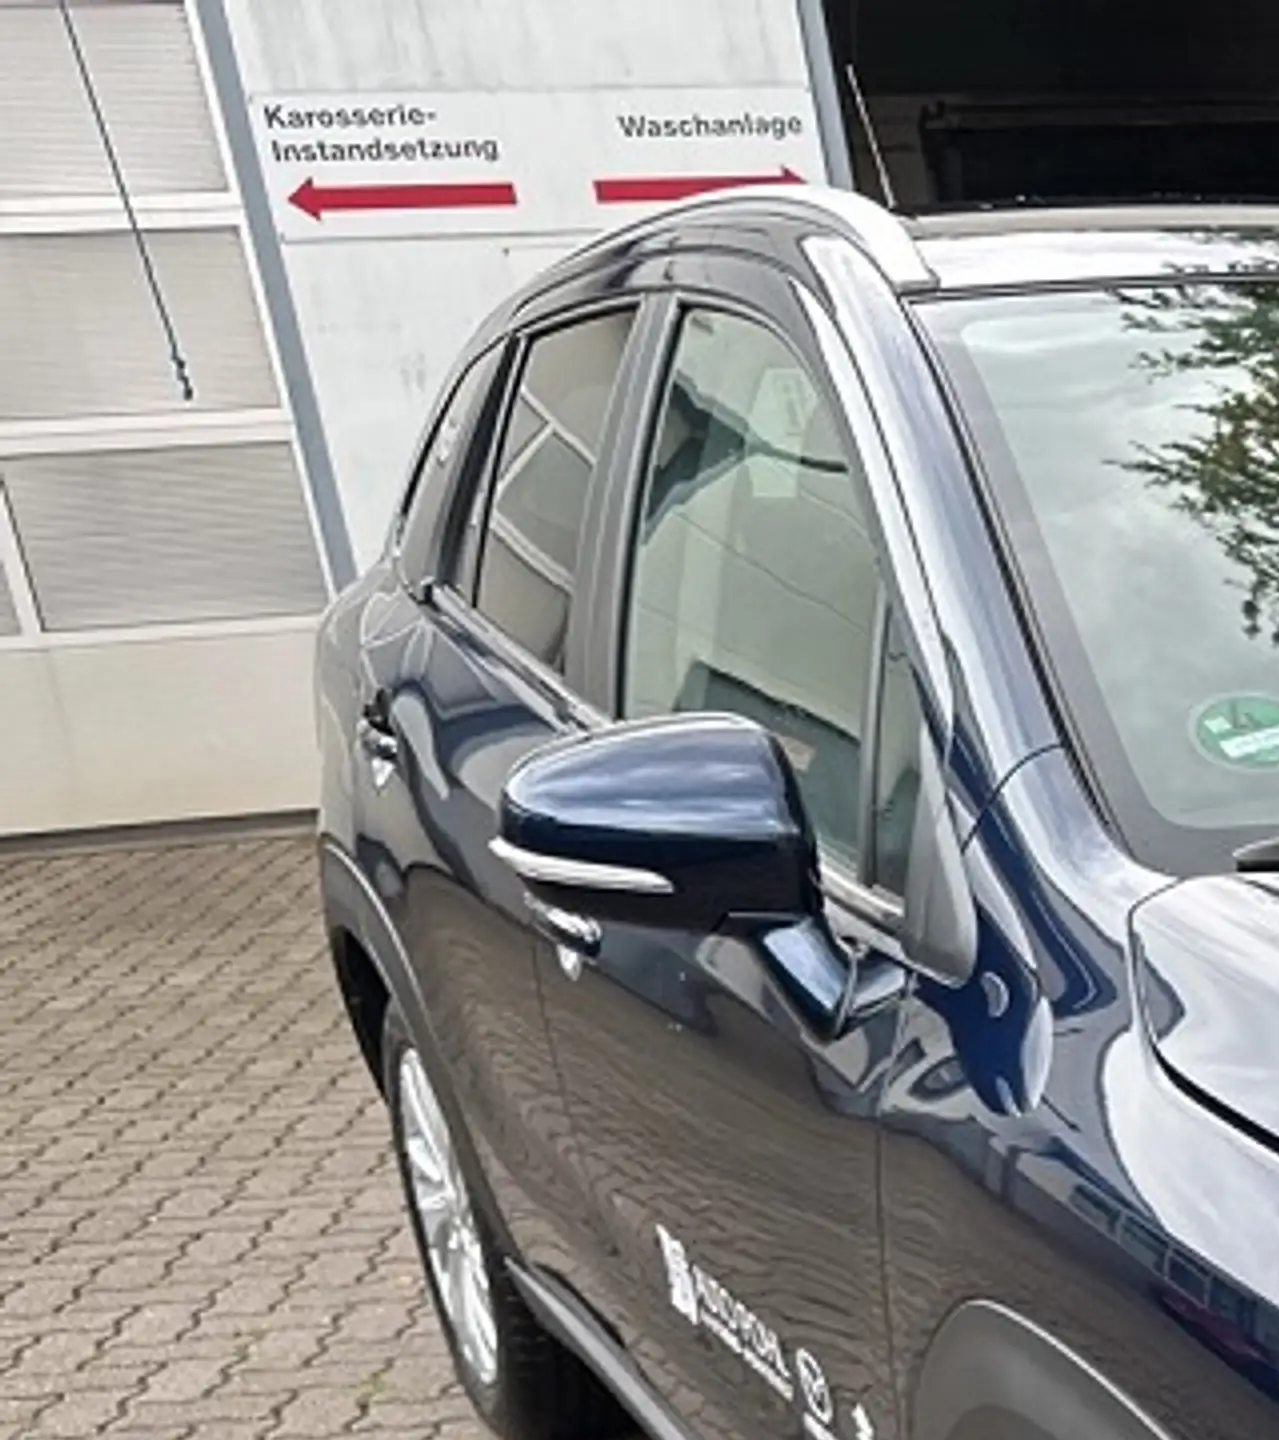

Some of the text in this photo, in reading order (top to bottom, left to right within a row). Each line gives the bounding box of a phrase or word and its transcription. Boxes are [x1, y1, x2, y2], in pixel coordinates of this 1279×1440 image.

[263, 103, 437, 130] Karosserie-
[616, 113, 804, 139] Waschanlage
[271, 136, 499, 163] Instandsetzung
